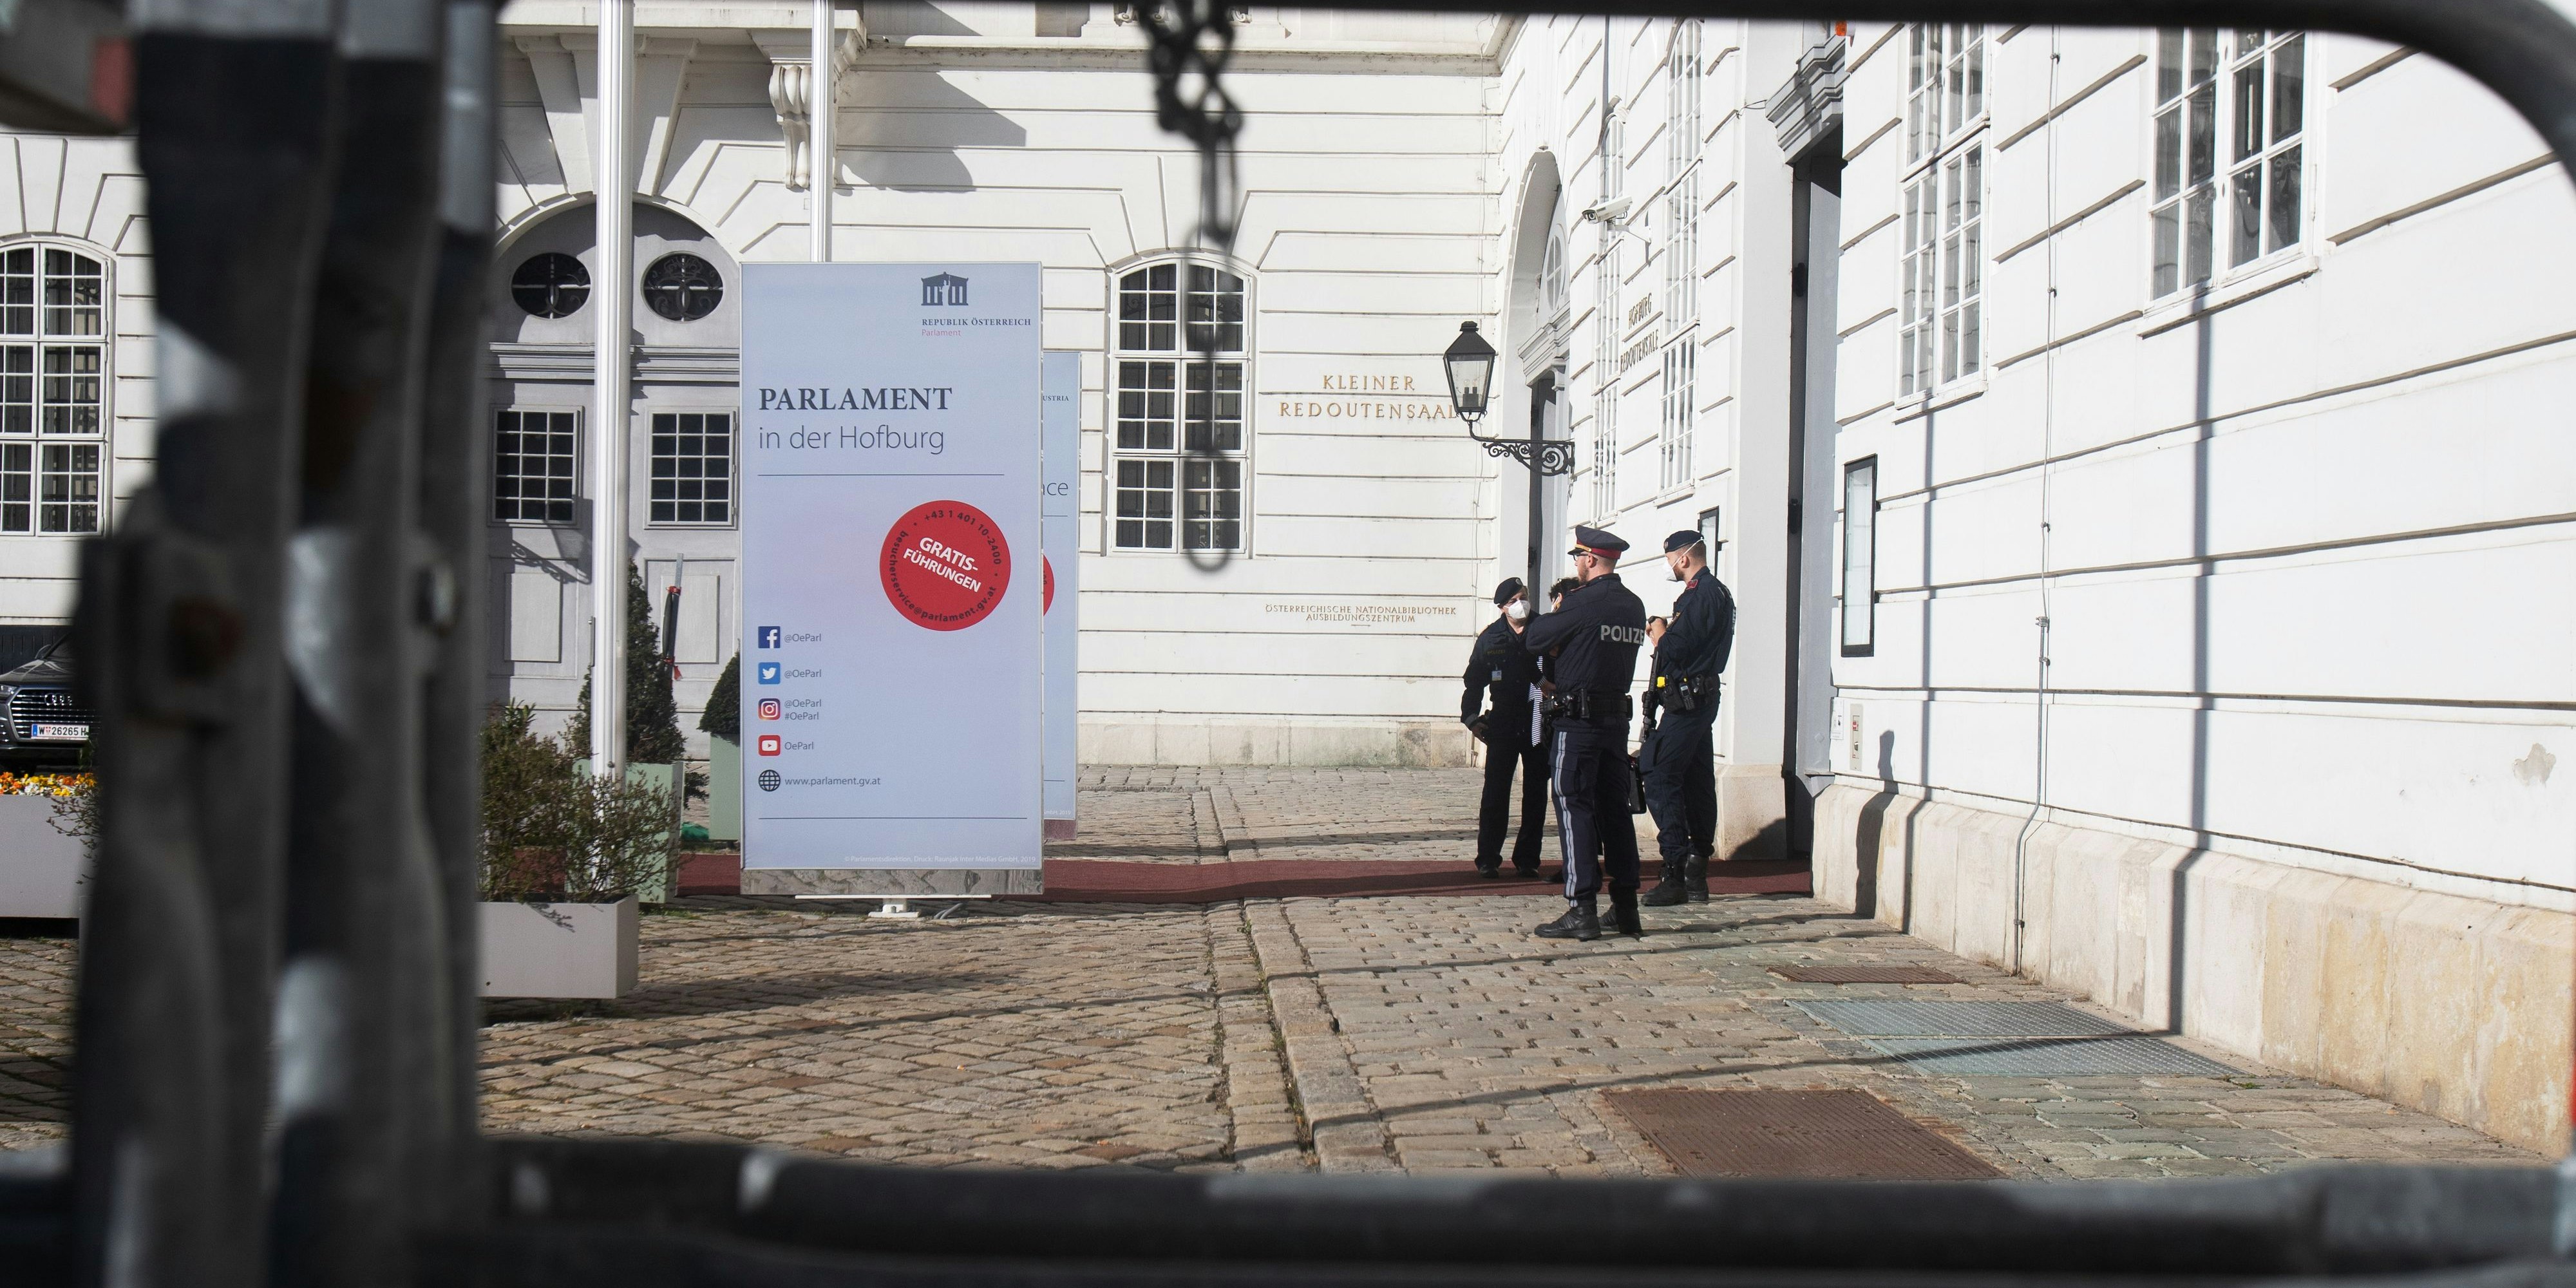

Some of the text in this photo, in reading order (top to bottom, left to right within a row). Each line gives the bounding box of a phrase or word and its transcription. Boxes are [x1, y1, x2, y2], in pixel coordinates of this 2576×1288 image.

[971, 317, 1031, 326] ÖSTERREICH
[1323, 375, 1415, 391] KLEINER
[759, 387, 952, 411] PARLAMENT
[1280, 401, 1458, 419] REDOUTENSAAL
[759, 424, 944, 455] in der Hofburg
[1043, 482, 1068, 496] ce
[925, 510, 944, 520] +43
[958, 513, 976, 525] 401
[978, 524, 1001, 564] 10-2400
[919, 537, 978, 571] GRATIS-
[889, 530, 996, 622] besucherservice@parlament.gv.at
[903, 548, 981, 592] FÜHRUNGEN
[1265, 603, 1457, 615] ÖSTERREICHISCHE NATIONALBIBLIOTHEK
[1306, 613, 1416, 623] AUSBILDUNGSZENTRUM
[784, 633, 821, 643] @OeParl
[1600, 625, 1644, 646] POLIZE
[784, 669, 822, 679] @OeParl
[784, 699, 822, 708] @OeParl
[784, 712, 819, 721] #OeParl
[39, 726, 45, 735] W
[52, 726, 79, 735] 26265
[784, 741, 814, 750] OeParl
[784, 777, 881, 787] www.parlament.gv.at
